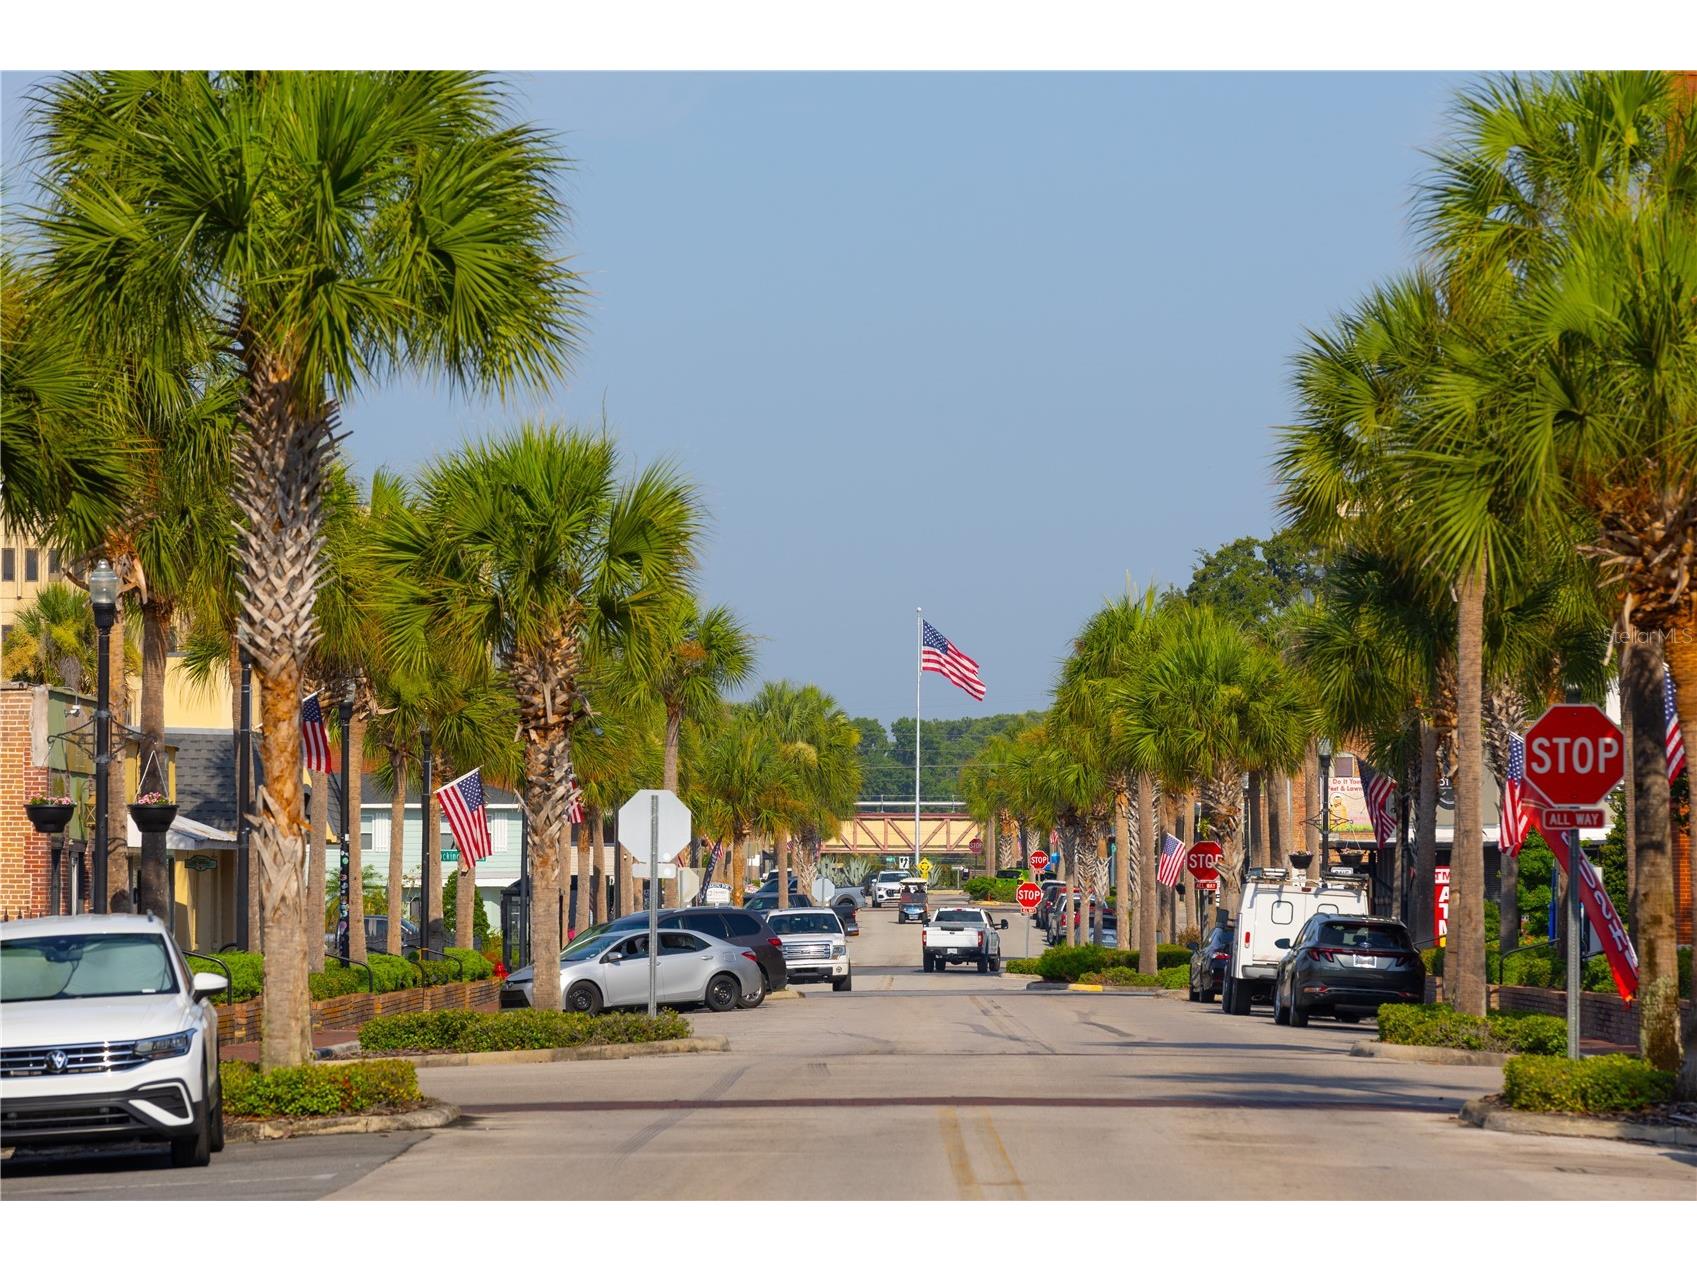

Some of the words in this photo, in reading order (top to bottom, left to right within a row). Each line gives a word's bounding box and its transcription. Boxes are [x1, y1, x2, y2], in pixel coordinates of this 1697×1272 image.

[1530, 736, 1619, 775] STOP
[1549, 813, 1571, 826] ALL
[1575, 813, 1600, 826] WAY
[1031, 856, 1047, 864] STOP
[1435, 871, 1451, 881] TM
[1018, 890, 1041, 900] STOP
